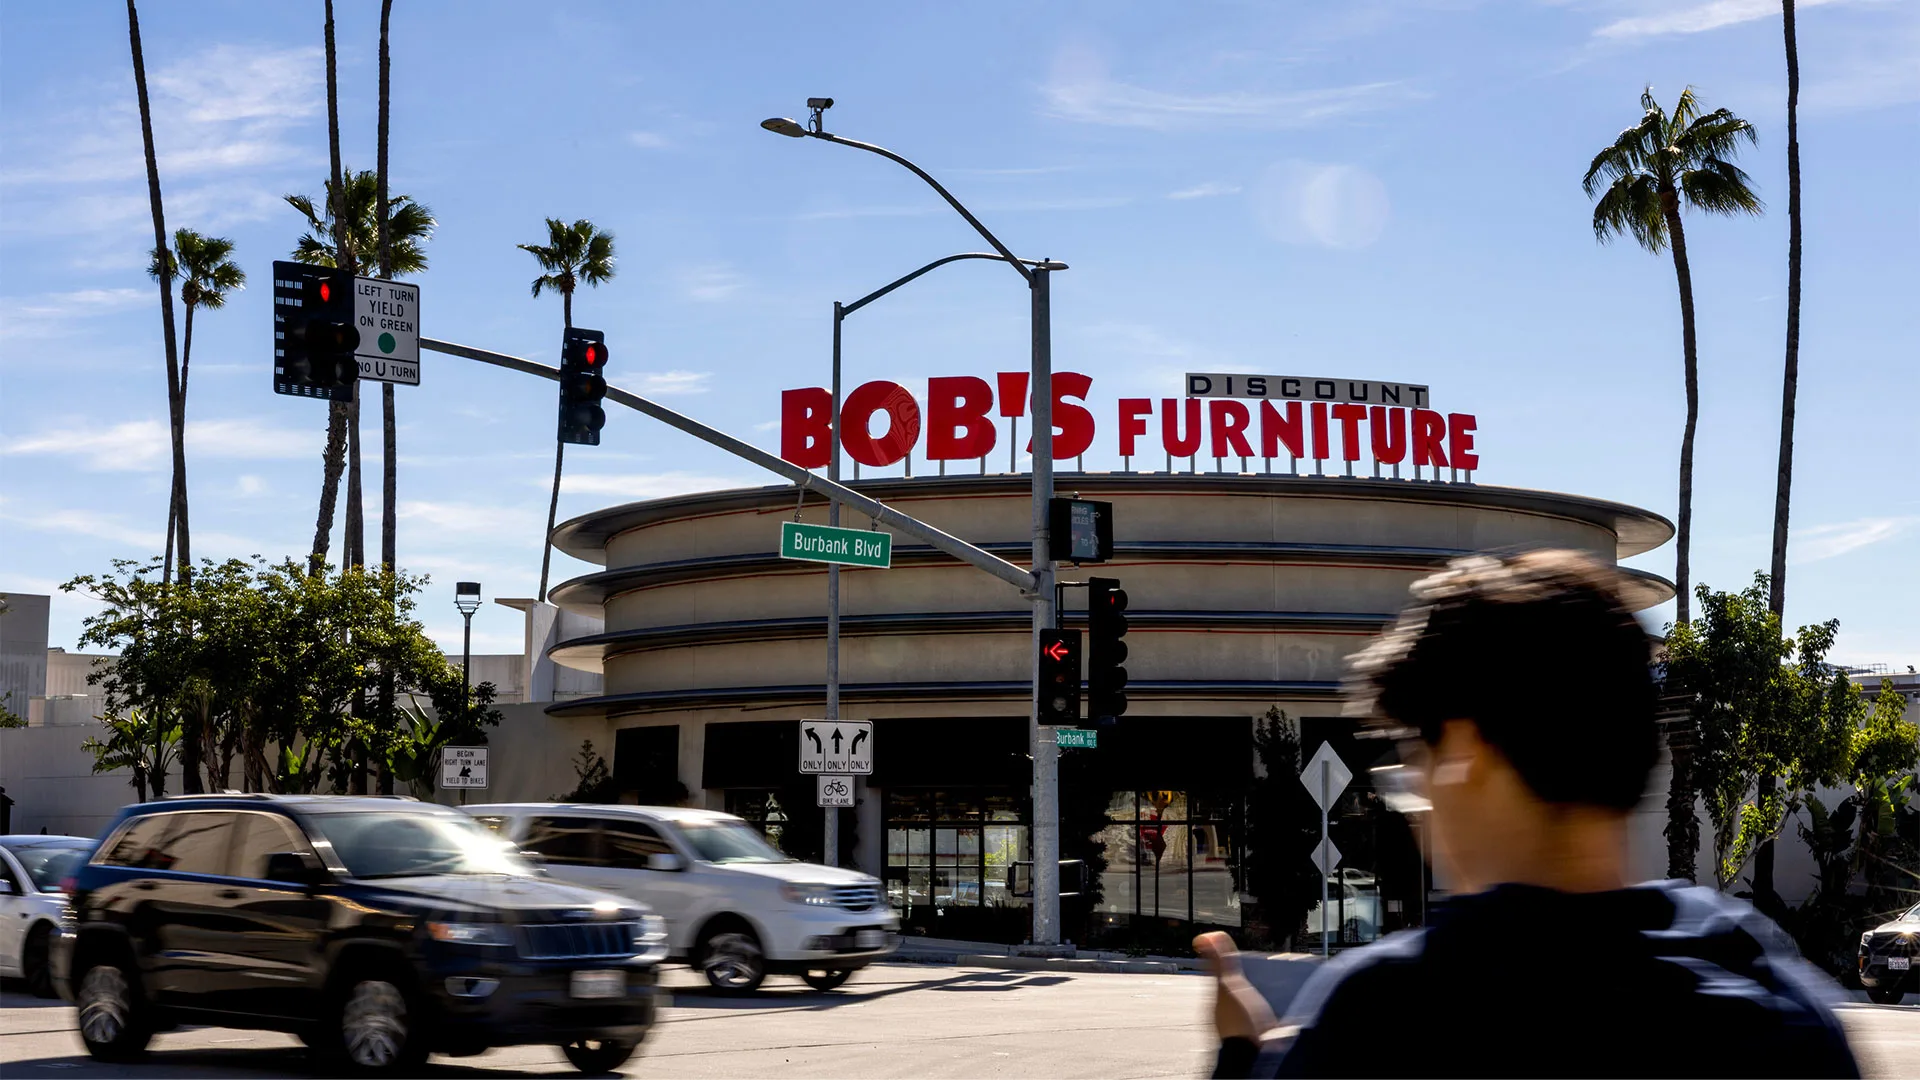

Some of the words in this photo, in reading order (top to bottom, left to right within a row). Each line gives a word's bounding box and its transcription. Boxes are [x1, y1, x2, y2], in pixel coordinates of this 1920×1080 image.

[358, 284, 382, 297] LEFT
[389, 289, 414, 302] TURN
[369, 300, 404, 317] YIELD
[360, 315, 374, 327] ON
[380, 318, 413, 333] GREEN
[357, 361, 371, 373] NO
[375, 361, 386, 377] U
[390, 365, 416, 379] TURN
[1189, 375, 1427, 405] DISCOUNT
[781, 371, 1095, 469] BOB'S
[1118, 398, 1479, 470] FURNITURE
[794, 532, 848, 554] Burbank
[854, 538, 882, 558] Blvd
[1056, 732, 1084, 745] Burbank
[456, 750, 475, 758] BEGIN
[474, 759, 486, 767] LANE
[803, 760, 822, 770] ONLY
[827, 760, 847, 770] ONLY
[850, 760, 870, 770] ONLY
[461, 777, 468, 785] TO
[469, 777, 484, 785] BIKES
[822, 797, 833, 805] BIKE
